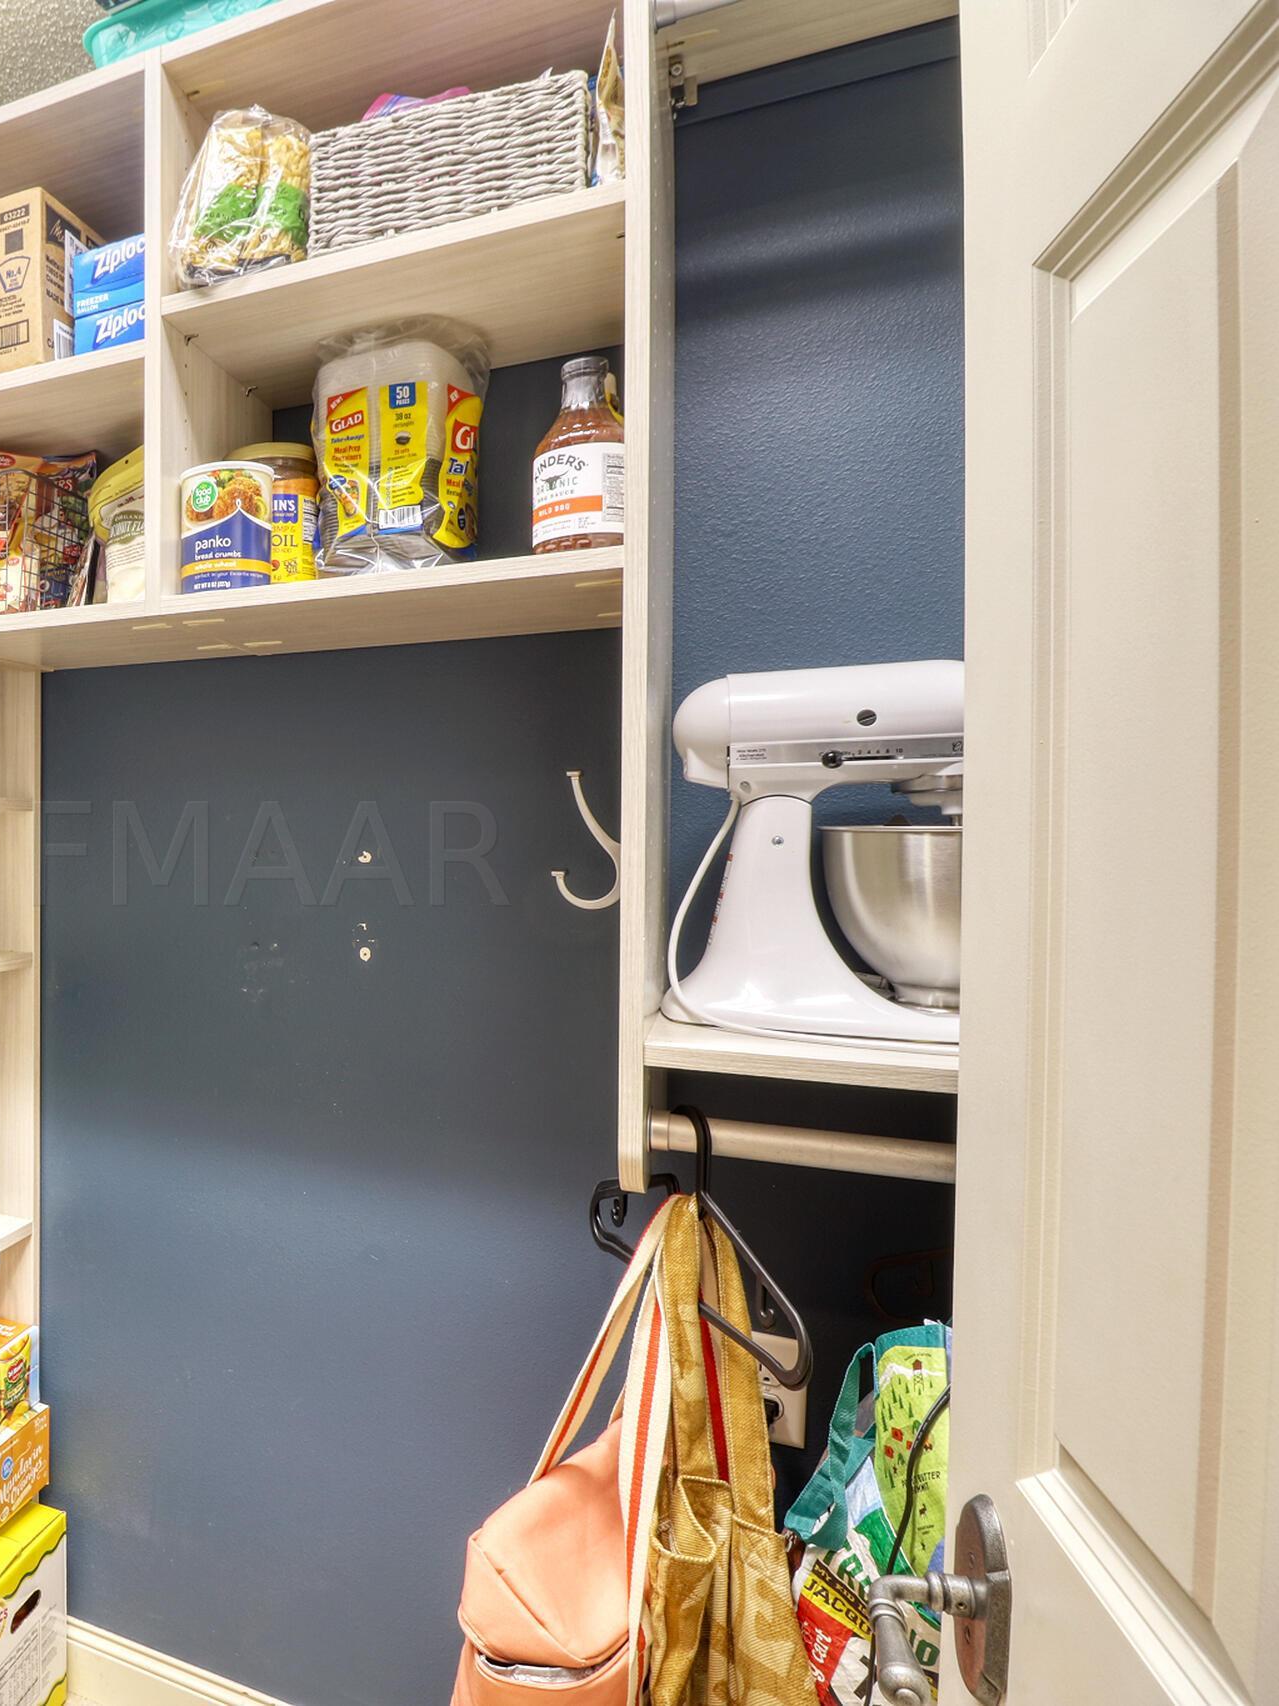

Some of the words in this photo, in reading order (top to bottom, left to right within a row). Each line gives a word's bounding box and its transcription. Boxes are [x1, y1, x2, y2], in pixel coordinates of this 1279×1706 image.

[3, 208, 26, 222] 63222
[94, 236, 145, 279] Ziploc
[77, 293, 109, 307] FREEZER
[96, 302, 145, 343] Ziploc
[396, 386, 410, 400] 50
[331, 412, 362, 433] GLAD
[334, 446, 348, 455] Meal
[348, 445, 361, 455] Prep
[196, 486, 212, 497] food
[536, 476, 578, 495] ORNIC
[195, 495, 211, 506] club
[273, 499, 296, 512] IN'S
[115, 512, 145, 522] ORGANI
[195, 535, 232, 553] panko
[272, 534, 298, 547] OIL
[195, 552, 213, 561] bread
[0, 1444, 44, 1505] Mandarin
[815, 1564, 827, 1578] MY
[815, 1627, 833, 1664] cart
